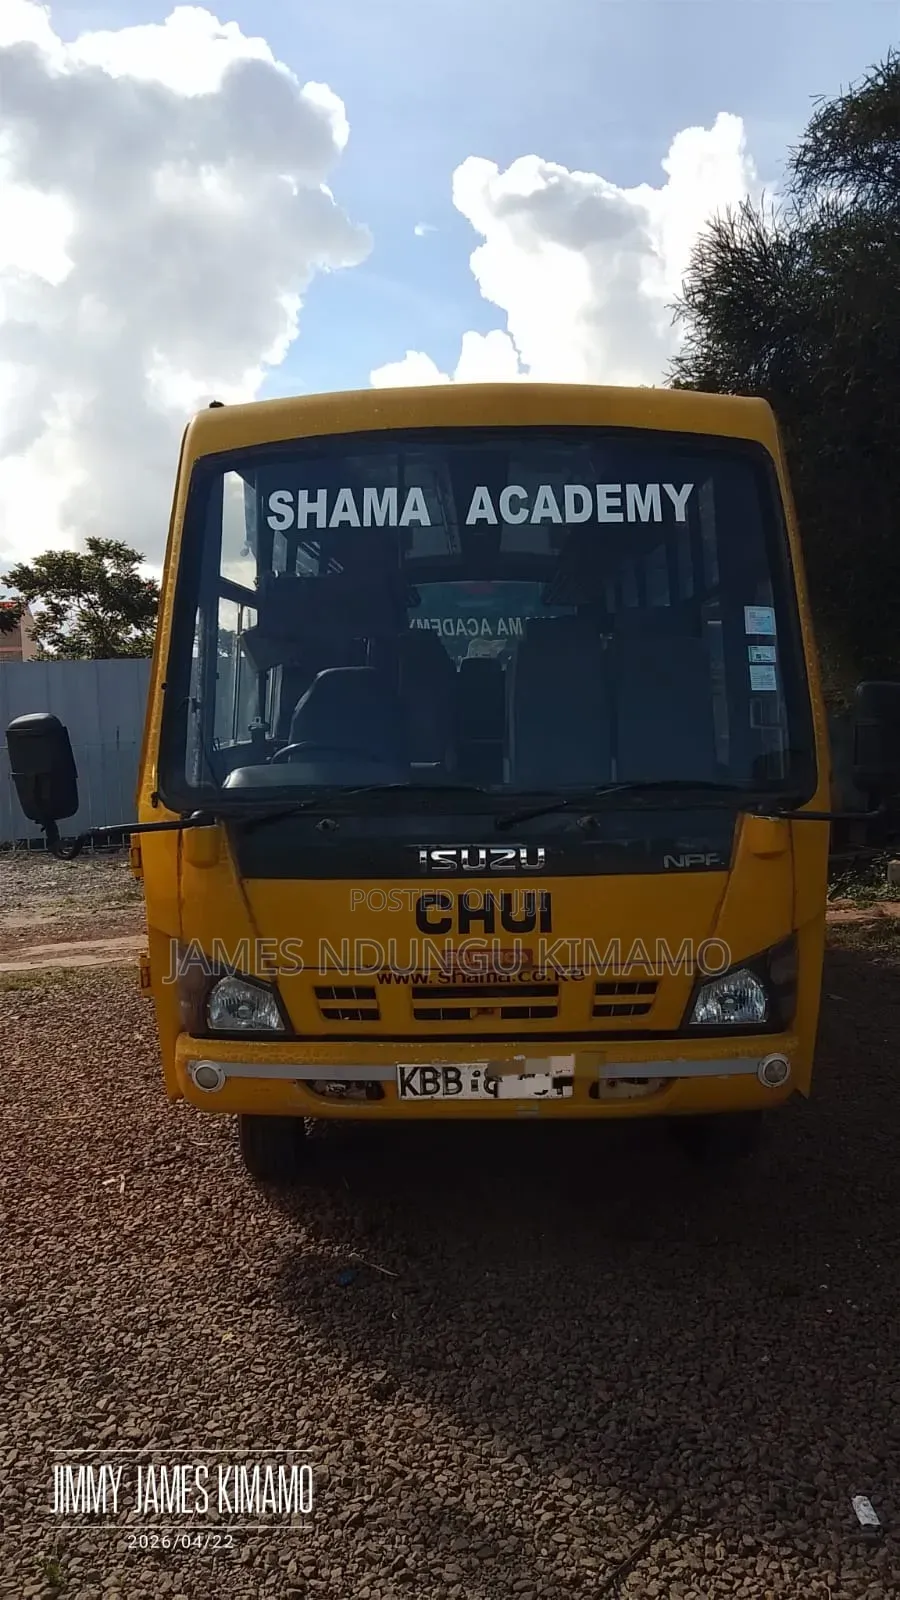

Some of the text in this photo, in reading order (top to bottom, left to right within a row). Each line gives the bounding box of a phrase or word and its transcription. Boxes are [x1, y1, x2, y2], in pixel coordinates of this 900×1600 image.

[267, 483, 694, 531] SHAMA ACADEMY
[419, 848, 546, 872] ISUZU
[415, 892, 553, 935] CHUI
[399, 1065, 464, 1097] KBB
